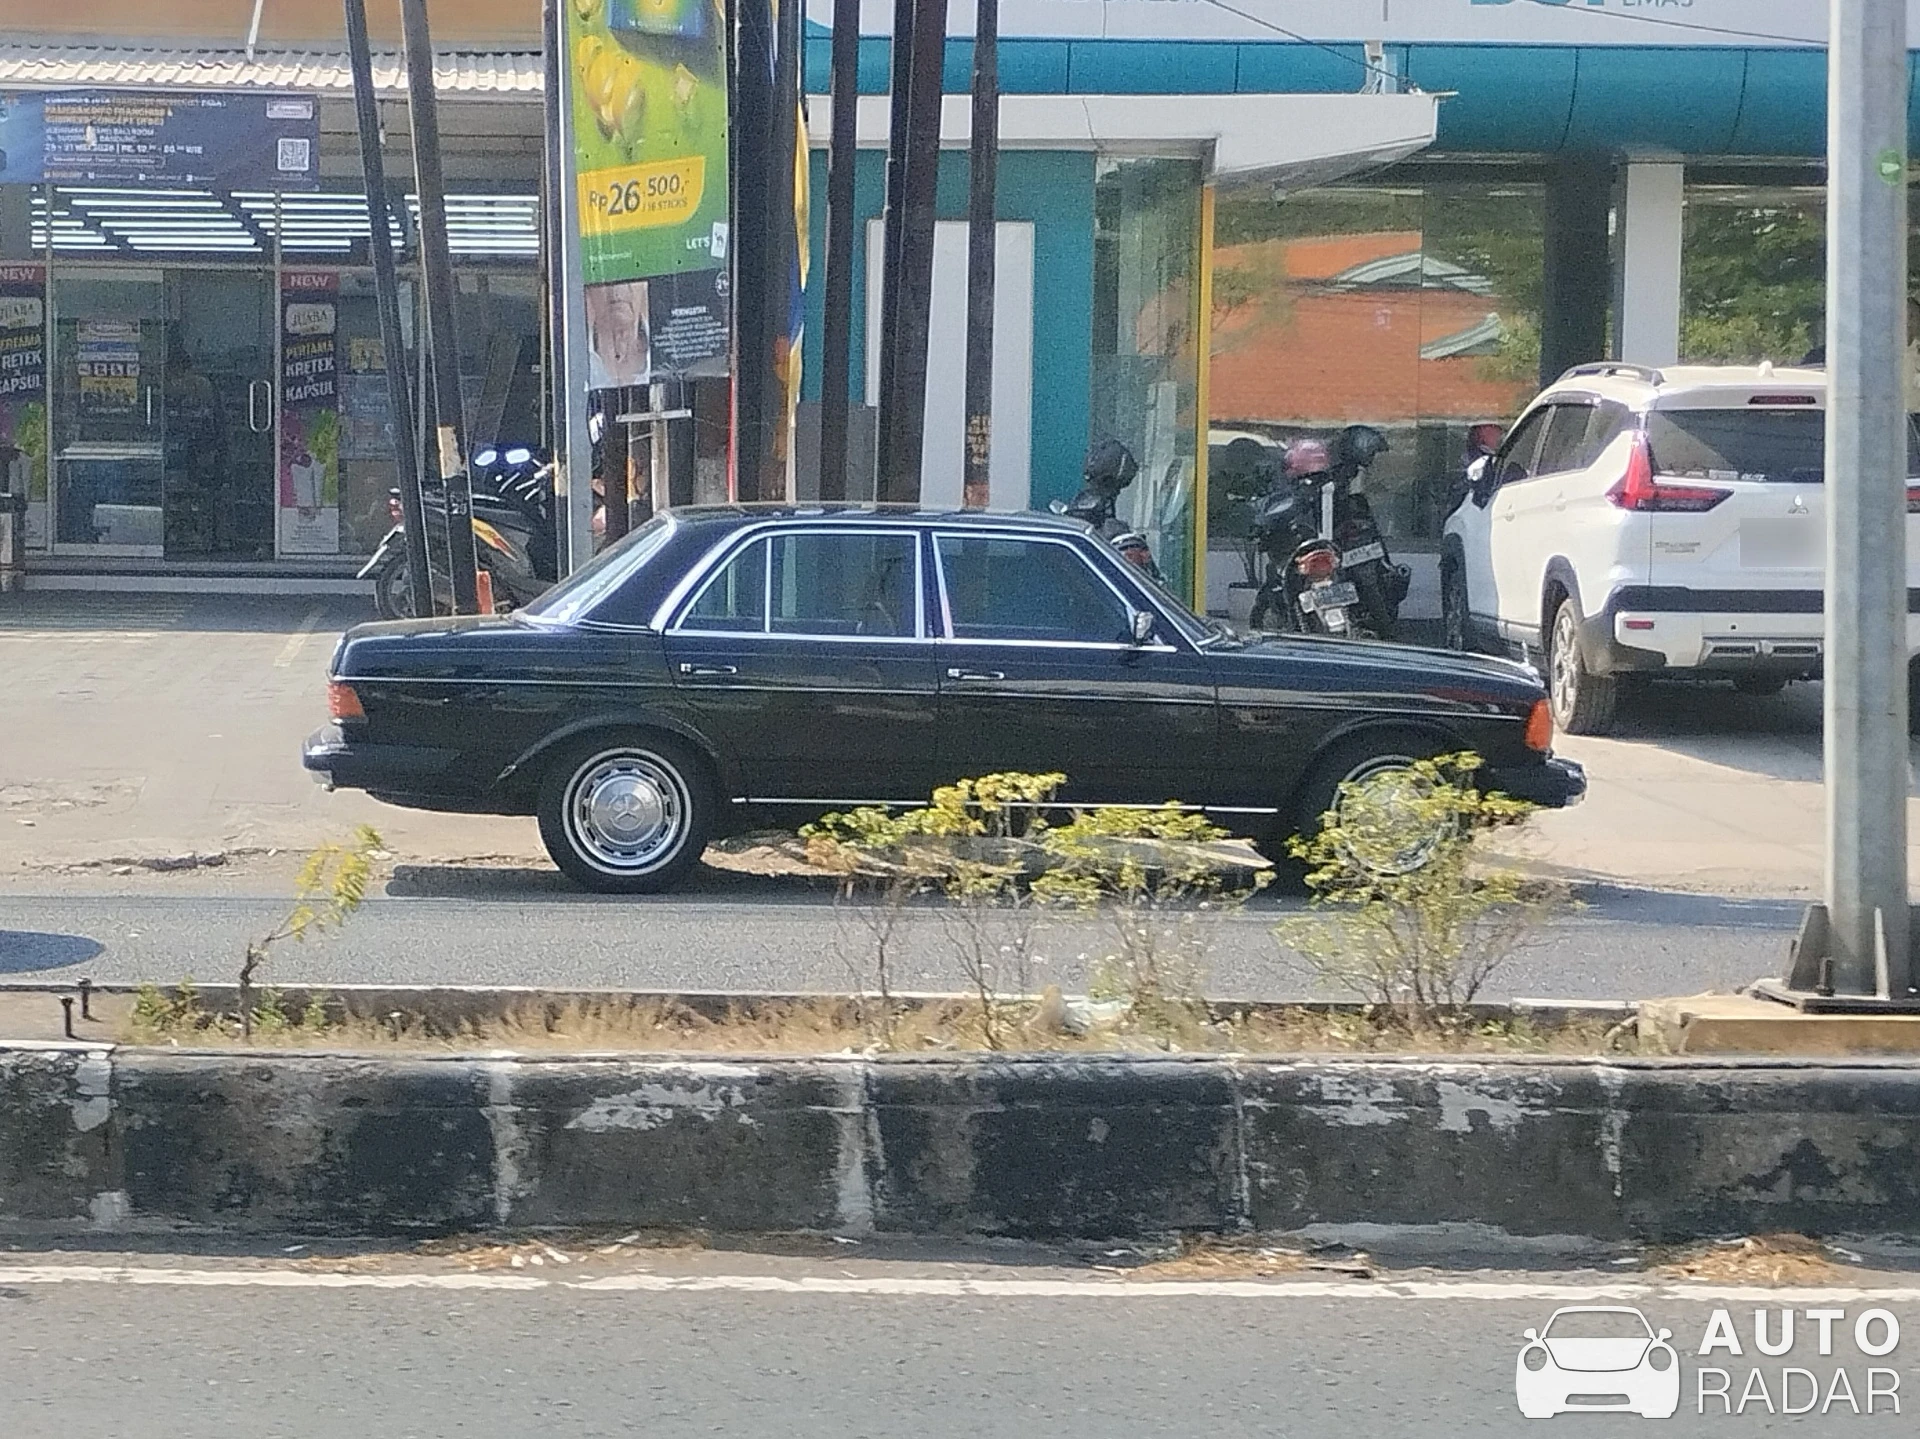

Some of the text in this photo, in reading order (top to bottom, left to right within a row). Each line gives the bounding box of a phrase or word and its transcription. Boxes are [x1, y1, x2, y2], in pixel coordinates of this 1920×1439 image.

[290, 274, 329, 287] NEW
[1, 349, 42, 370] RETEK
[285, 357, 335, 377] KRETEK
[0, 373, 41, 394] APSUL
[285, 381, 335, 401] KAPSUL
